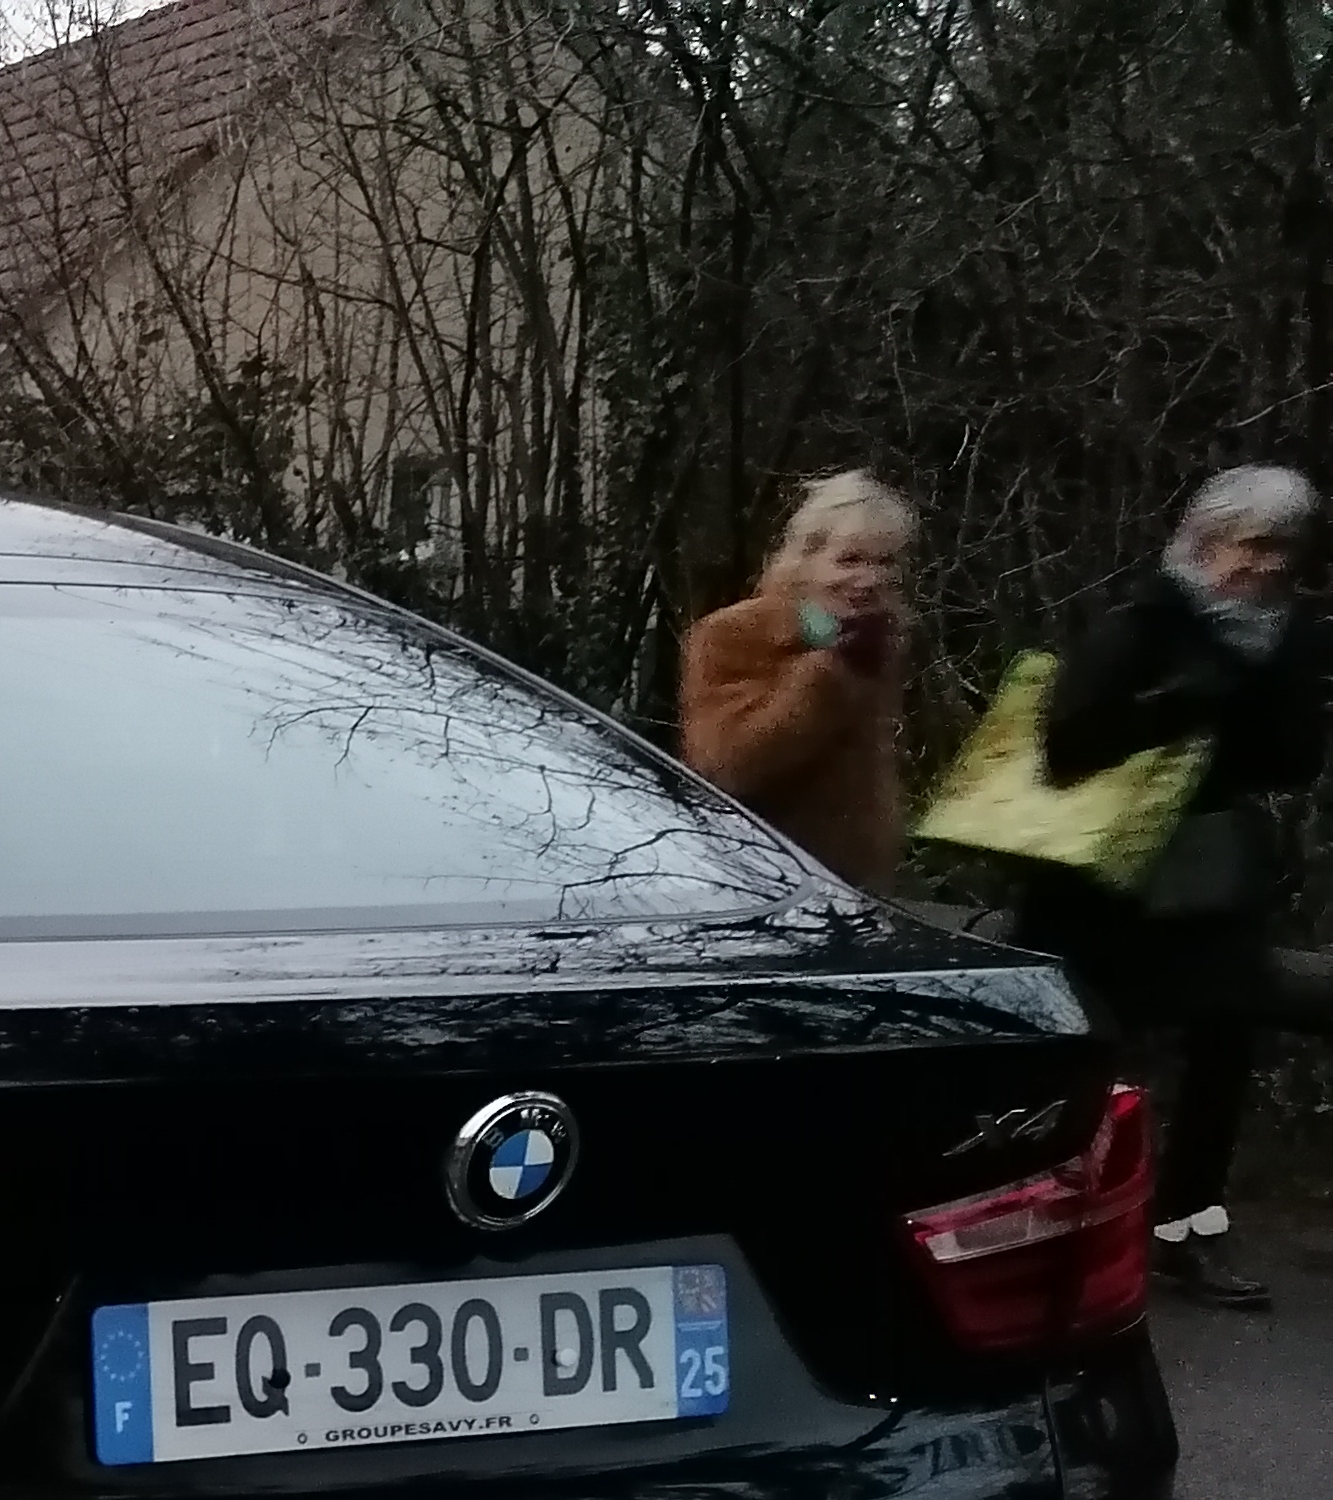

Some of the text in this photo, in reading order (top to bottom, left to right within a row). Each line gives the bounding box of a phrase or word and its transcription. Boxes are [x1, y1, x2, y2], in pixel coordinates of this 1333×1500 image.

[171, 1286, 656, 1428] EQ-330-DR
[679, 1345, 727, 1398] 25
[115, 1401, 132, 1433] F
[325, 1415, 513, 1442] GROUPESAVY.FR
